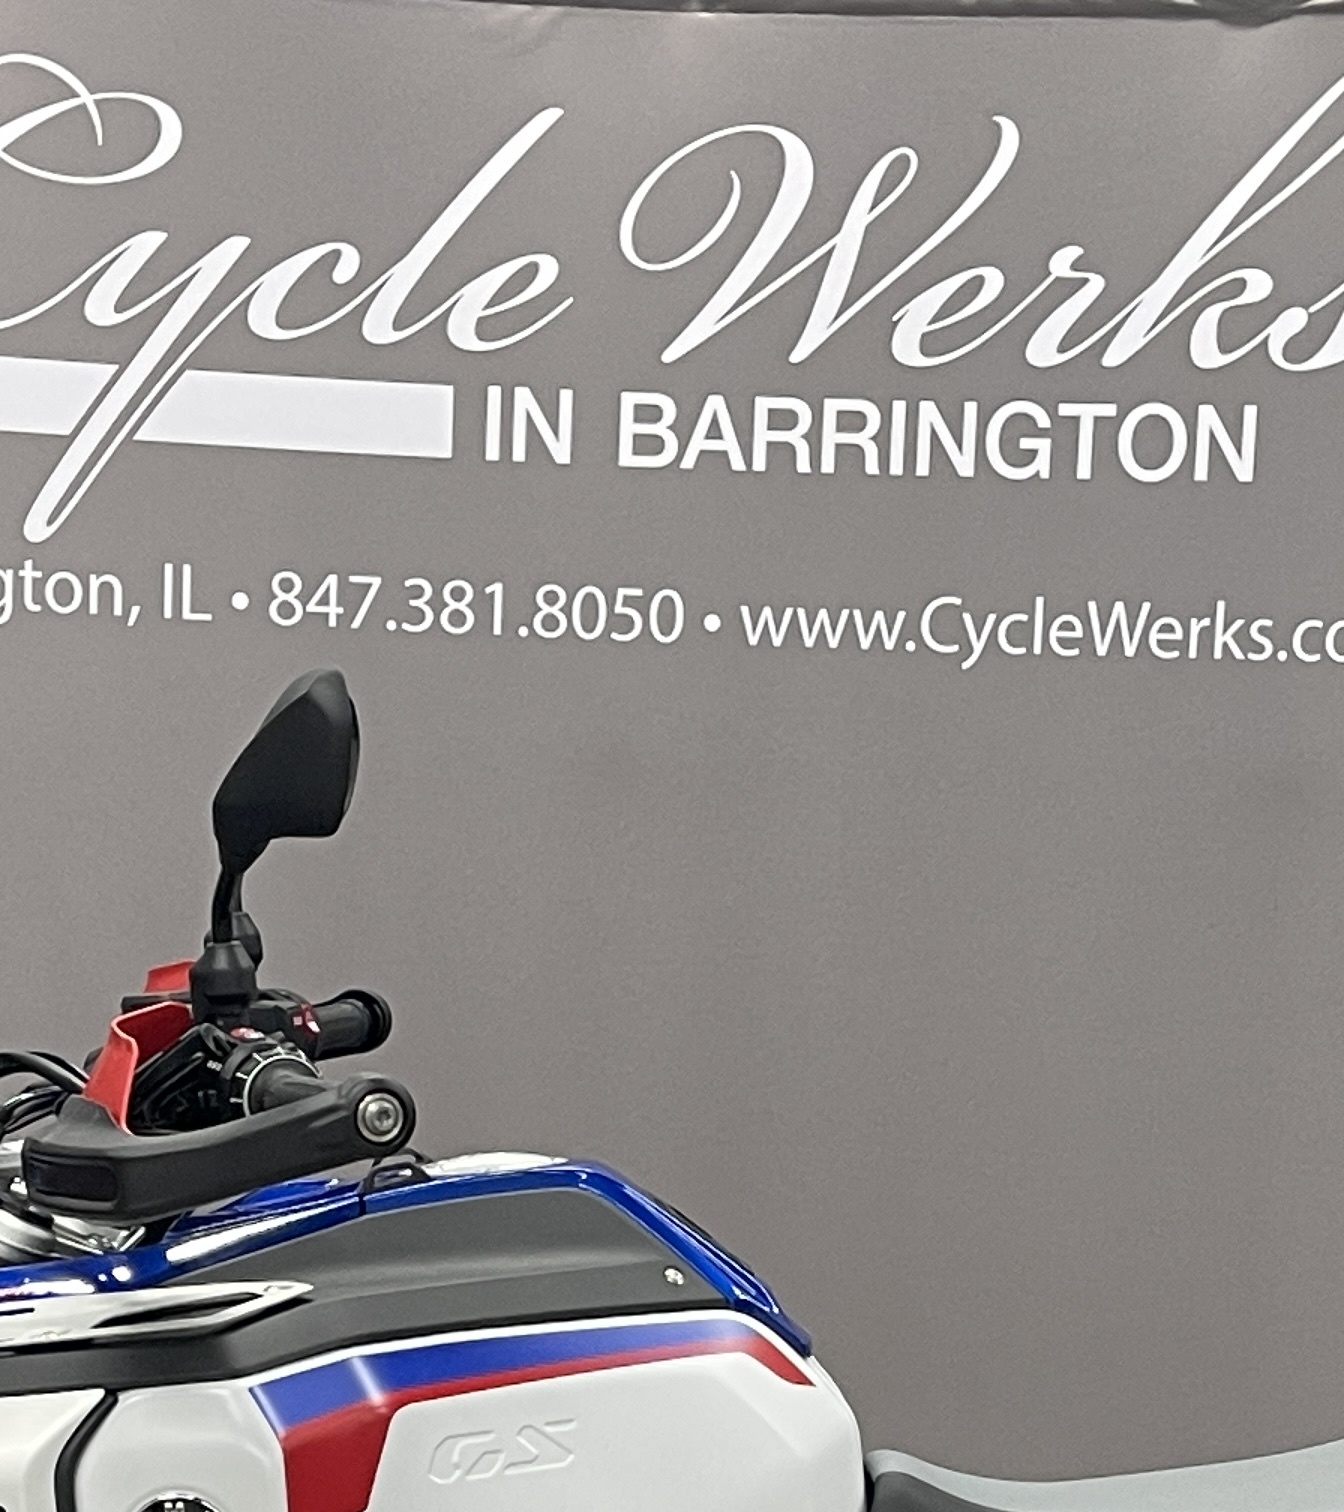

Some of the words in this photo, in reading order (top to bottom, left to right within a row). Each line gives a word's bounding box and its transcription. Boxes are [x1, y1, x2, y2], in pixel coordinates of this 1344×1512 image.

[485, 385, 574, 465] IN
[617, 391, 1258, 483] BARRINGTON
[164, 562, 213, 621] IL
[268, 571, 685, 644] 847.381.8050
[427, 1418, 578, 1485] GS
